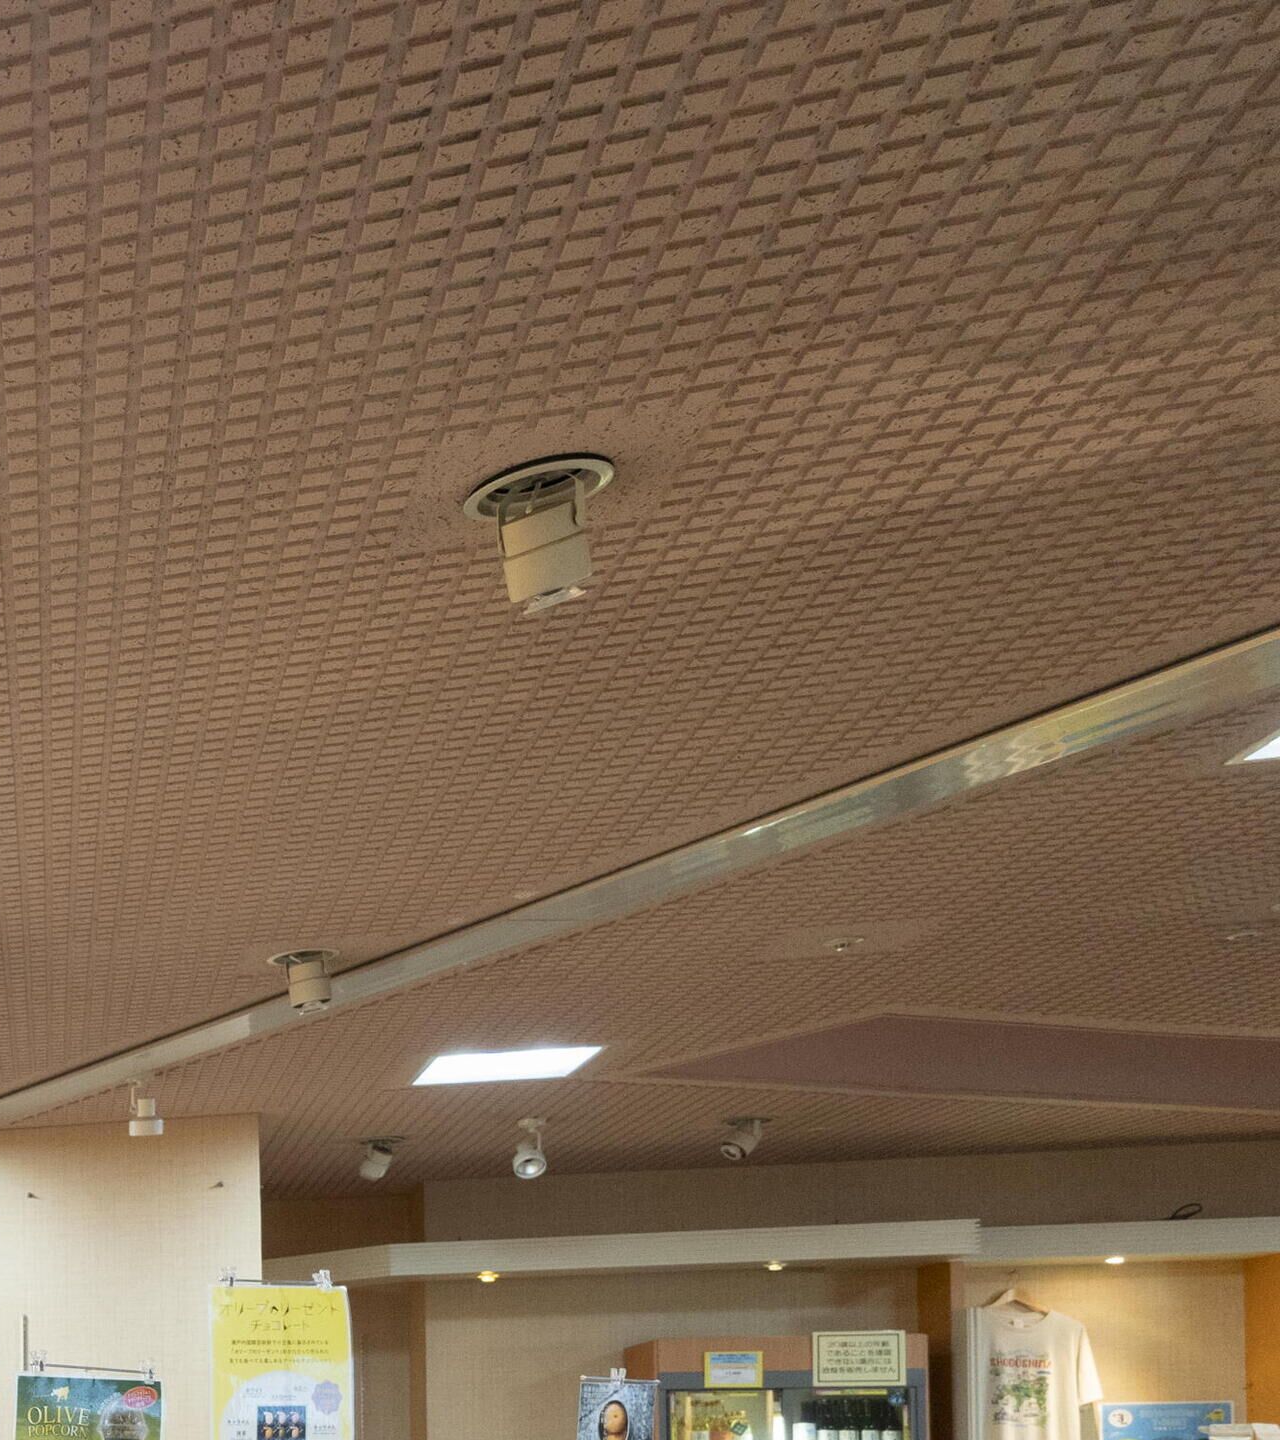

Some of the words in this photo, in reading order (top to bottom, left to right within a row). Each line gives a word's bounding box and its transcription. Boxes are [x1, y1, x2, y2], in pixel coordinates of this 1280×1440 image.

[250, 1318, 311, 1333] チョコレート
[27, 1405, 90, 1426] OLIVE
[27, 1424, 88, 1438] POPCORN
